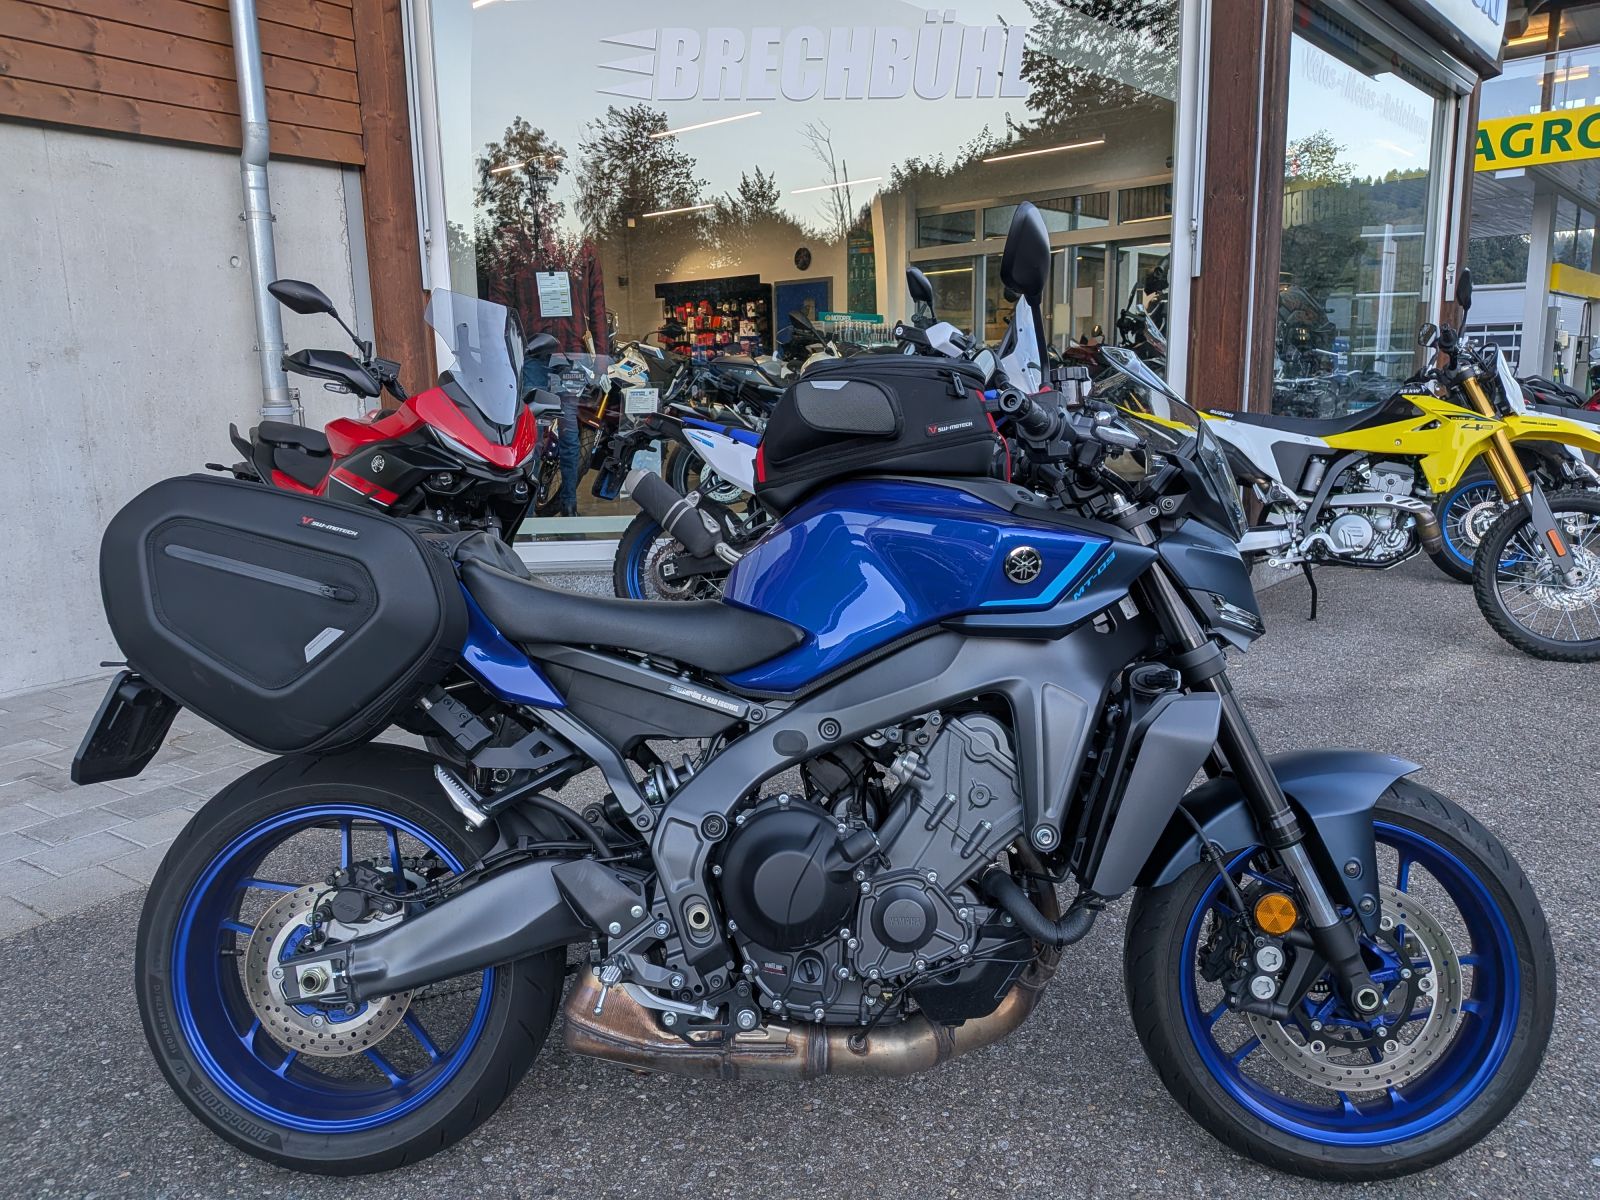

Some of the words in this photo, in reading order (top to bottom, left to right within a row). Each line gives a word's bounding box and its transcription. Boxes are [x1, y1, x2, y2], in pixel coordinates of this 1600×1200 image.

[656, 9, 1029, 101] BRECHBÜHL
[1073, 550, 1116, 601] MT-09
[192, 1083, 274, 1145] BRIDGESTONE
